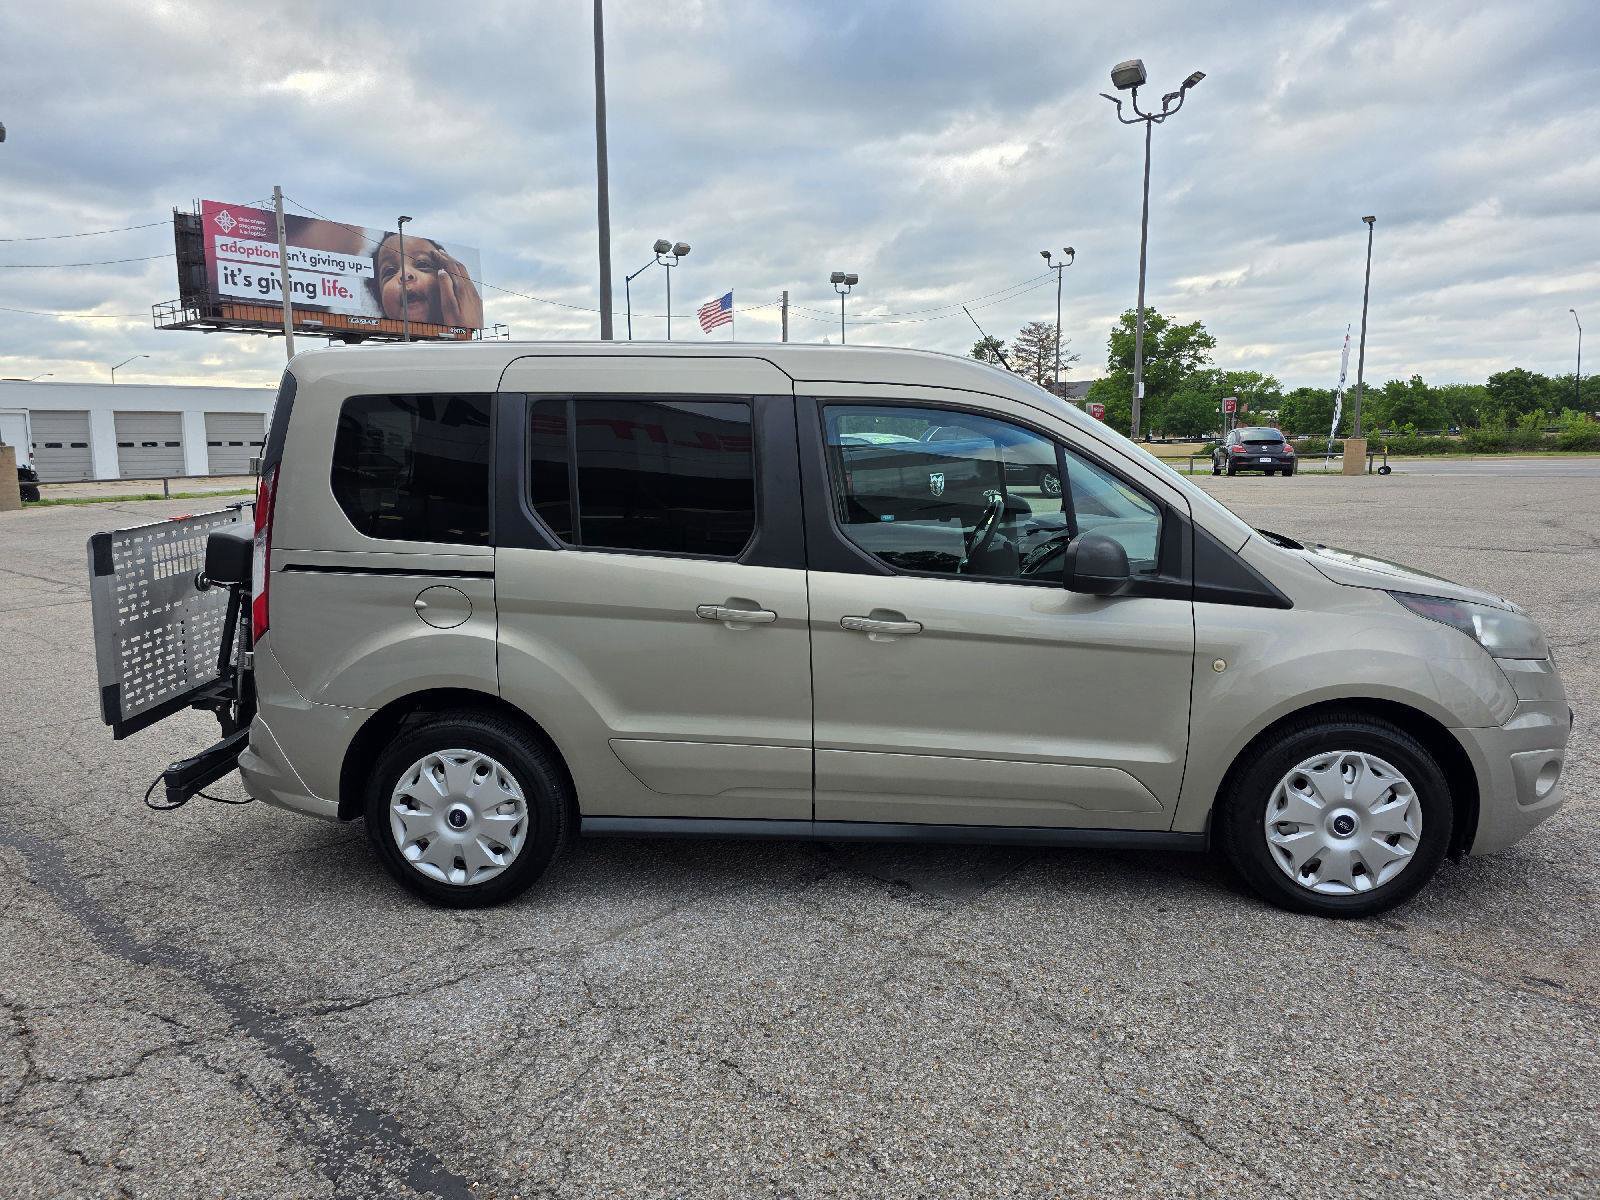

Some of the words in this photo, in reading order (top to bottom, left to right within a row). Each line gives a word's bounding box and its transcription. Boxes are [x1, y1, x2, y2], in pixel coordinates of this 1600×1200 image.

[220, 241, 279, 259] adoption
[286, 251, 307, 263] sn't
[310, 253, 345, 271] giving
[223, 266, 253, 288] it's
[321, 278, 354, 299] life.
